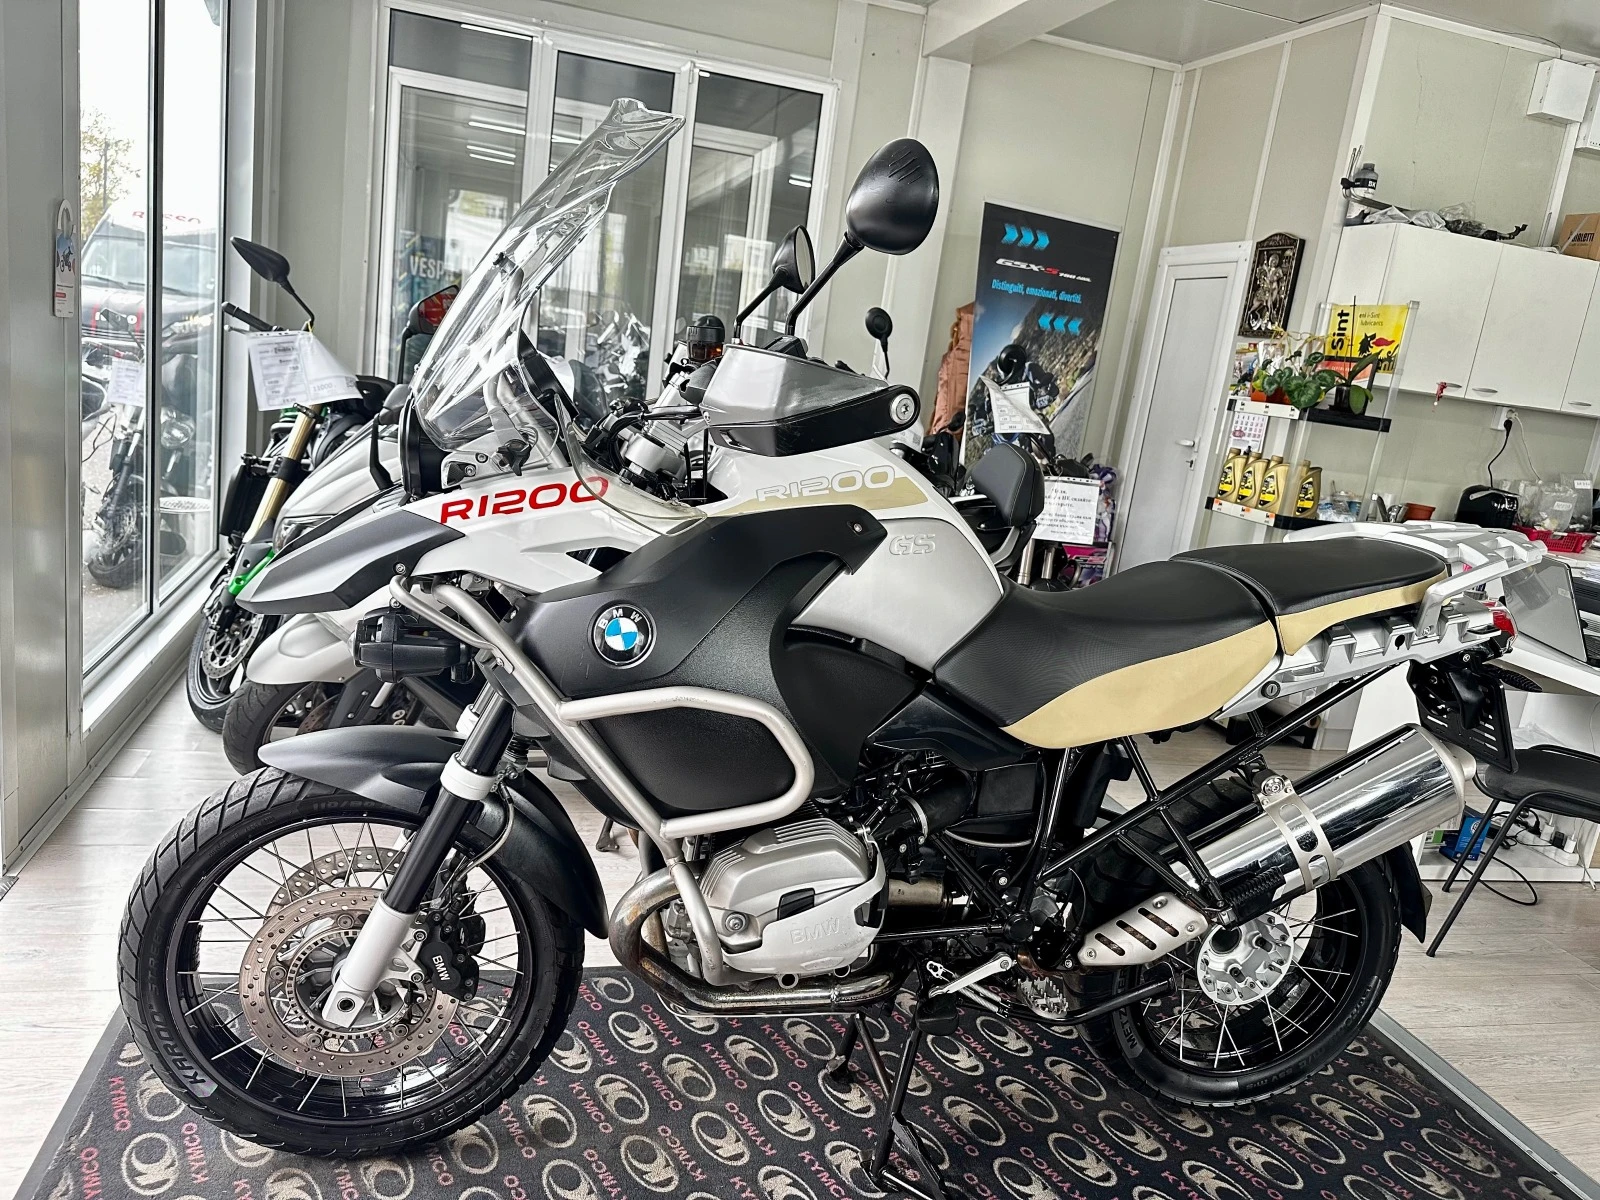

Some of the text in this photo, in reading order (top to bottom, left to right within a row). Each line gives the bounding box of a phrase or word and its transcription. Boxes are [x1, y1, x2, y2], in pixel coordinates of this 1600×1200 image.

[991, 278, 1082, 304] Distinguiti, emozionati, divertiti.
[440, 476, 609, 524] R1200
[755, 464, 896, 502] R1200
[888, 533, 936, 556] GS
[597, 608, 643, 630] BMW
[789, 916, 840, 945] BMW
[432, 955, 451, 981] BMW
[151, 1010, 207, 1086] KAROO
[577, 1020, 618, 1066] KYMCO
[640, 1004, 682, 1047] KYMCO
[760, 1024, 808, 1068] KYMCO
[638, 1061, 683, 1111] KYMCO
[701, 1042, 747, 1089] KYMCO
[1024, 1064, 1085, 1110] KYMCO
[108, 1075, 132, 1132] KYMCO
[498, 1098, 537, 1159] KYMCO
[569, 1081, 614, 1134] KYMCO
[787, 1081, 841, 1132] KYMCO
[974, 1083, 1034, 1133] KYMCO
[1120, 1101, 1188, 1151] KYMCO
[1293, 1102, 1368, 1150] KYMCO
[1331, 1081, 1405, 1128] KYMCO
[181, 1122, 209, 1184] KYMCO
[657, 1125, 707, 1181] KYMCO
[725, 1102, 777, 1156] KYMCO
[919, 1104, 980, 1156] KYMCO
[1072, 1123, 1140, 1176] KYMCO
[1252, 1123, 1328, 1175] KYMCO
[80, 1147, 102, 1200] YMCO
[583, 1149, 628, 1200] YMCO
[798, 1151, 853, 1200] KYMC
[1020, 1146, 1088, 1200] KYMCO
[1208, 1146, 1284, 1200] KYMCO
[1400, 1140, 1483, 1193] KYMCO
